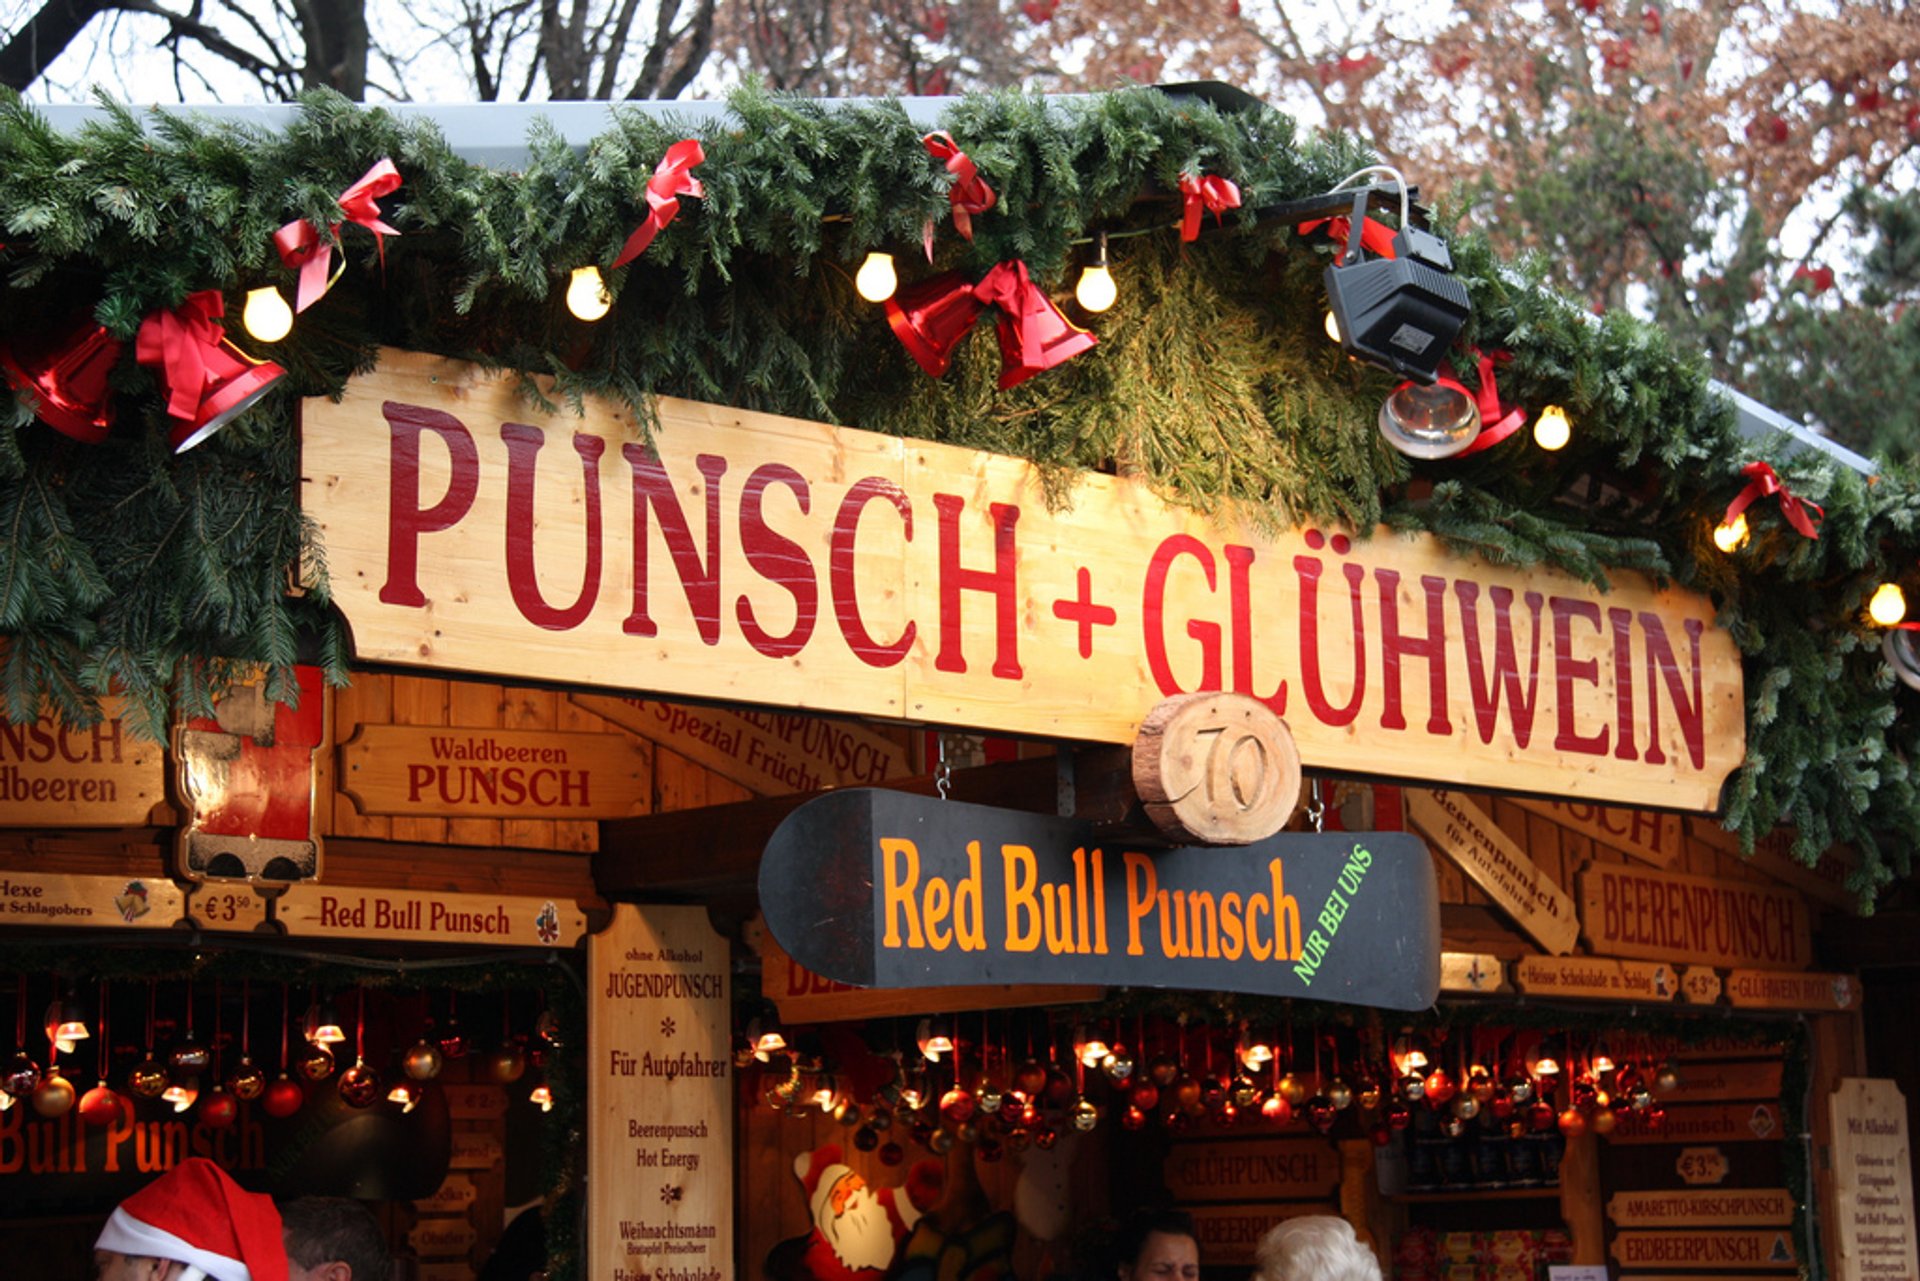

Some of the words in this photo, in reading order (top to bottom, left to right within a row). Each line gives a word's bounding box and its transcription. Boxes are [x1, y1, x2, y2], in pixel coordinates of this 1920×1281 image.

[379, 400, 1024, 680] PUNSCH
[1053, 566, 1117, 659] +
[1142, 528, 1704, 770] GLÜHWEIN
[655, 700, 741, 758] Spezial
[431, 736, 567, 765] Waldbeeren
[407, 763, 591, 808] PUNSCH
[1431, 788, 1560, 918] Beerenpunsch
[1446, 823, 1464, 847] für
[1468, 848, 1536, 915] Autofahrer
[10, 901, 93, 917] Schlagobers
[880, 837, 986, 951] Red
[1001, 843, 1108, 956] Bull
[1124, 852, 1303, 962] Punsch
[320, 897, 365, 928] Red
[375, 899, 422, 931] Bull
[431, 902, 511, 935] Punsch
[1293, 929, 1330, 986] NUR
[1318, 889, 1349, 936] BEI
[1337, 843, 1374, 895] UNS
[1602, 874, 1796, 962] BEERENPUNSCH
[625, 949, 653, 962] ohne
[657, 949, 703, 963] Alkohol
[606, 972, 723, 999] JUGENDPUNSCH
[1560, 967, 1607, 988] Schokolade
[610, 1051, 637, 1076] Für
[642, 1051, 726, 1079] Autofahrer
[629, 1120, 708, 1142] Beerenpunsch
[636, 1149, 659, 1167] Hot
[662, 1149, 699, 1170] Energy
[1626, 1198, 1785, 1218] AMARETTO-KIRSCHPUNSCH
[620, 1220, 716, 1240] Weihnachtsmann
[1626, 1237, 1760, 1261] ERDBEERPUNSCH
